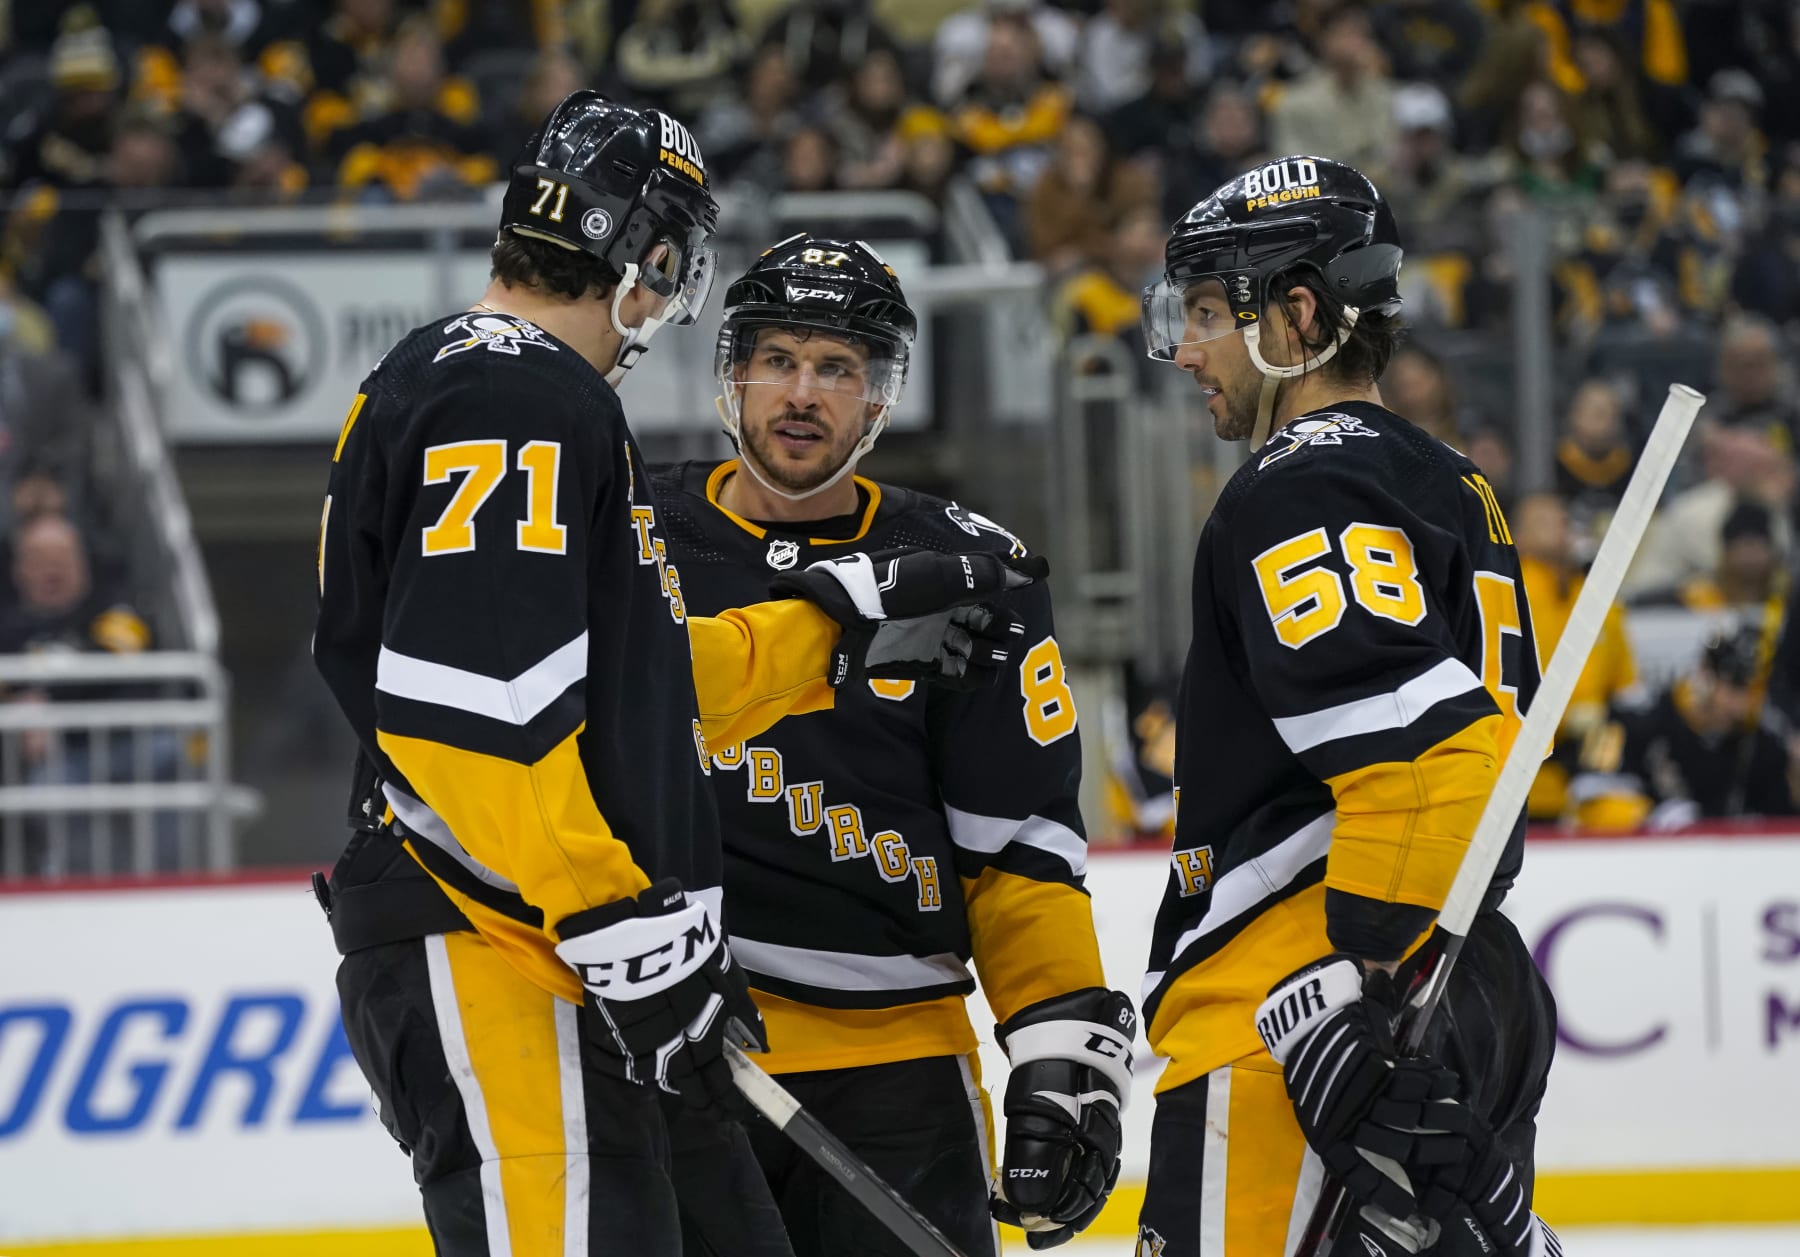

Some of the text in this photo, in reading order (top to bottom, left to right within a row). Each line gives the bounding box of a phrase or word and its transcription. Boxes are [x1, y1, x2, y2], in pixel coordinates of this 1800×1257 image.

[658, 112, 704, 169] BOLD
[660, 148, 704, 186] PENGUIN
[1244, 160, 1318, 199] BOLD
[529, 177, 570, 222] 71
[1246, 186, 1320, 212] PENGUIN
[802, 248, 849, 267] 87
[422, 439, 567, 557] 71
[773, 549, 793, 563] NHL
[1251, 522, 1427, 650] 58
[833, 653, 845, 684] CCM
[1171, 844, 1214, 897] H
[573, 910, 716, 987] CCM
[1118, 1007, 1136, 1029] 87
[1008, 1168, 1050, 1178] CCM
